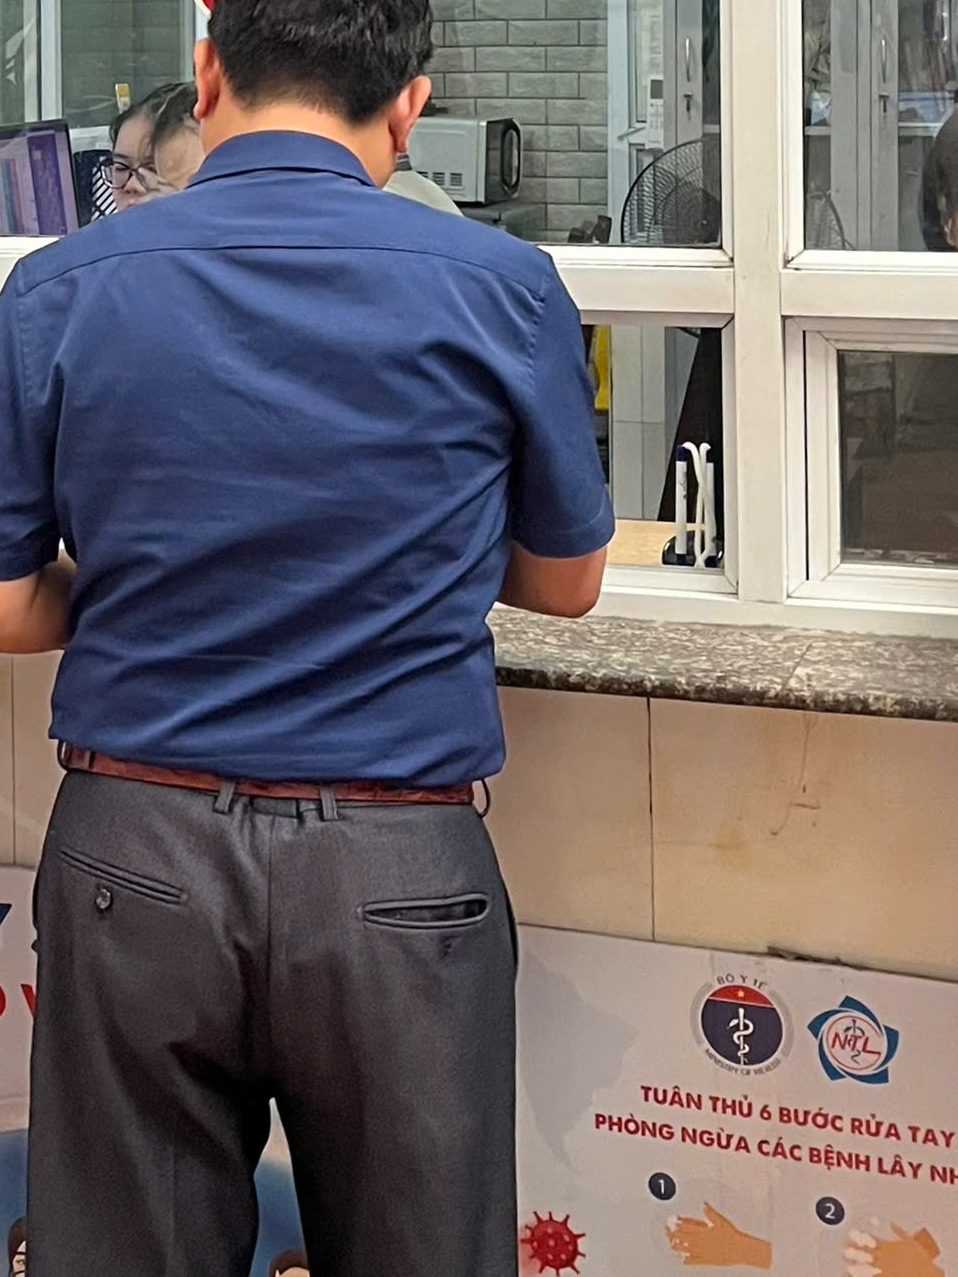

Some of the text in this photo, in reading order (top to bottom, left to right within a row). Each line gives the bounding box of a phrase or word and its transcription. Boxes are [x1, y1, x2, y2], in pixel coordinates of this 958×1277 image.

[594, 1112, 676, 1142] PHÒNG
[680, 1126, 751, 1155] NGỪA
[757, 1137, 803, 1162] CÁC
[808, 1145, 871, 1172] BỆNH
[877, 1154, 923, 1180] LÂY
[640, 1084, 956, 1149] TUÂN THỦ 6 BƯỚC RỬA TAY
